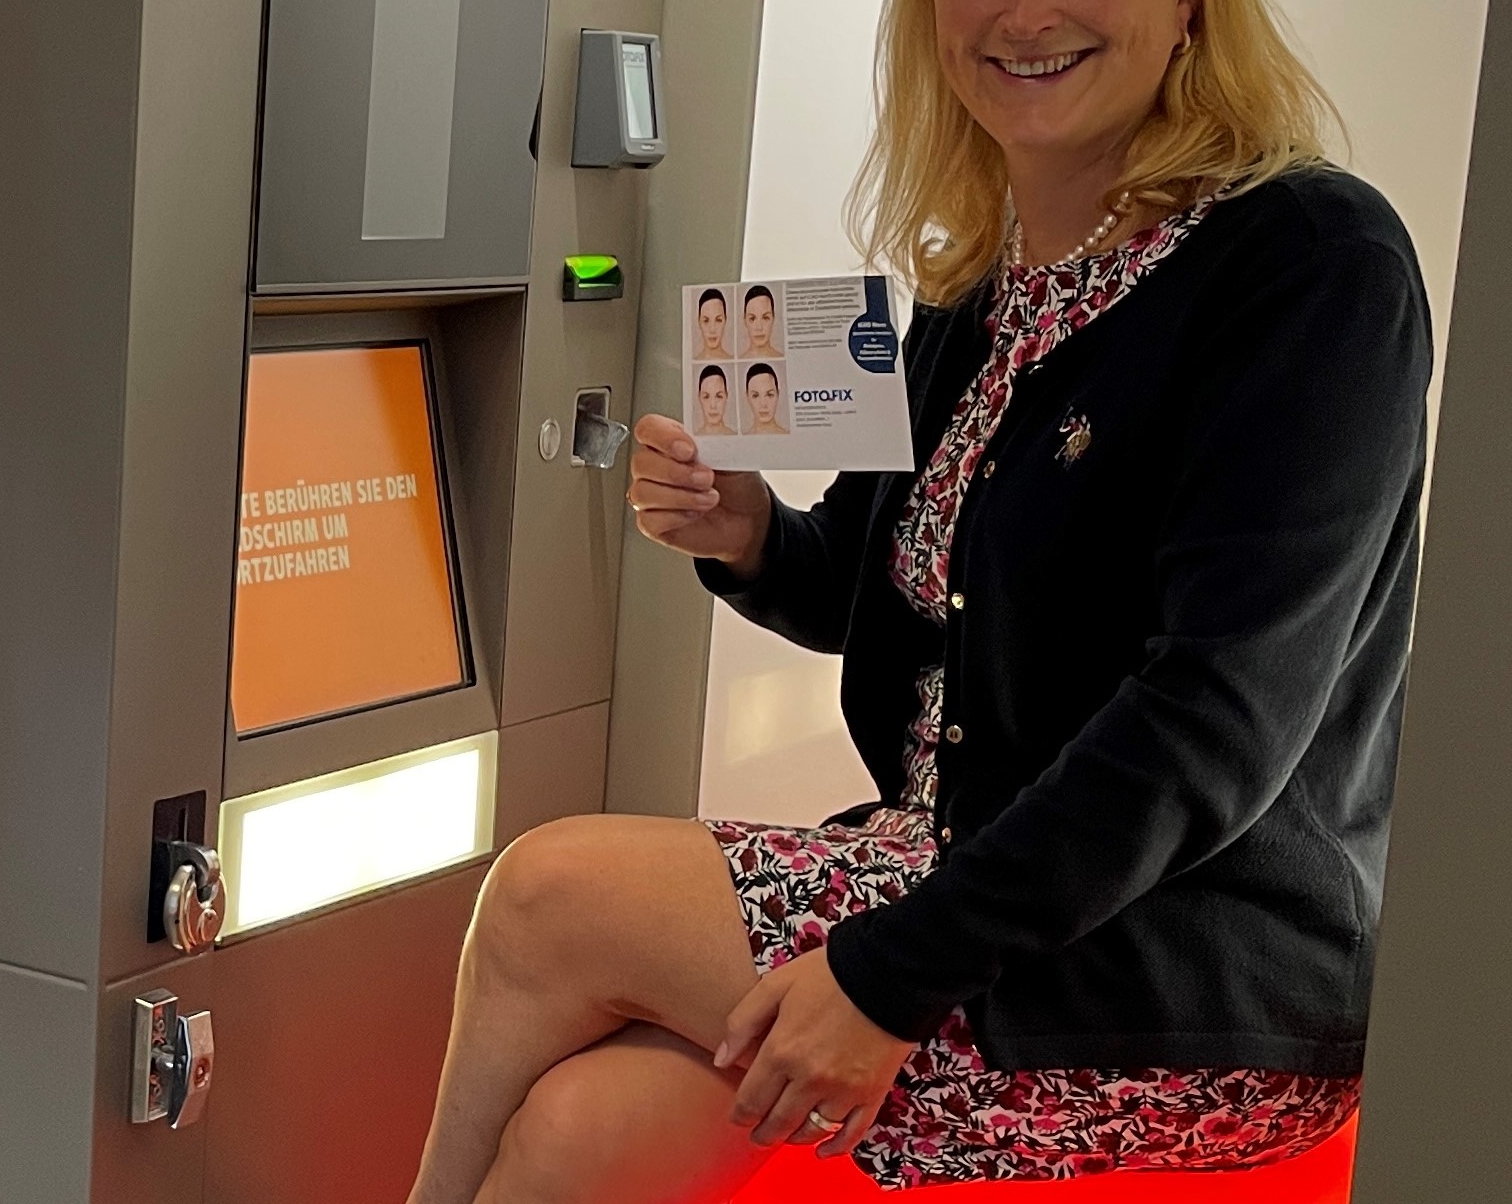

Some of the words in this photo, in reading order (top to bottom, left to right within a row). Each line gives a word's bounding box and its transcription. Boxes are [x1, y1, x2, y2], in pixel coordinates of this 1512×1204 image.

[264, 479, 353, 515] BERÜHREN
[356, 478, 383, 505] SIE
[385, 474, 418, 501] DEN
[238, 517, 319, 552] DSCHIRM
[322, 513, 349, 539] UM
